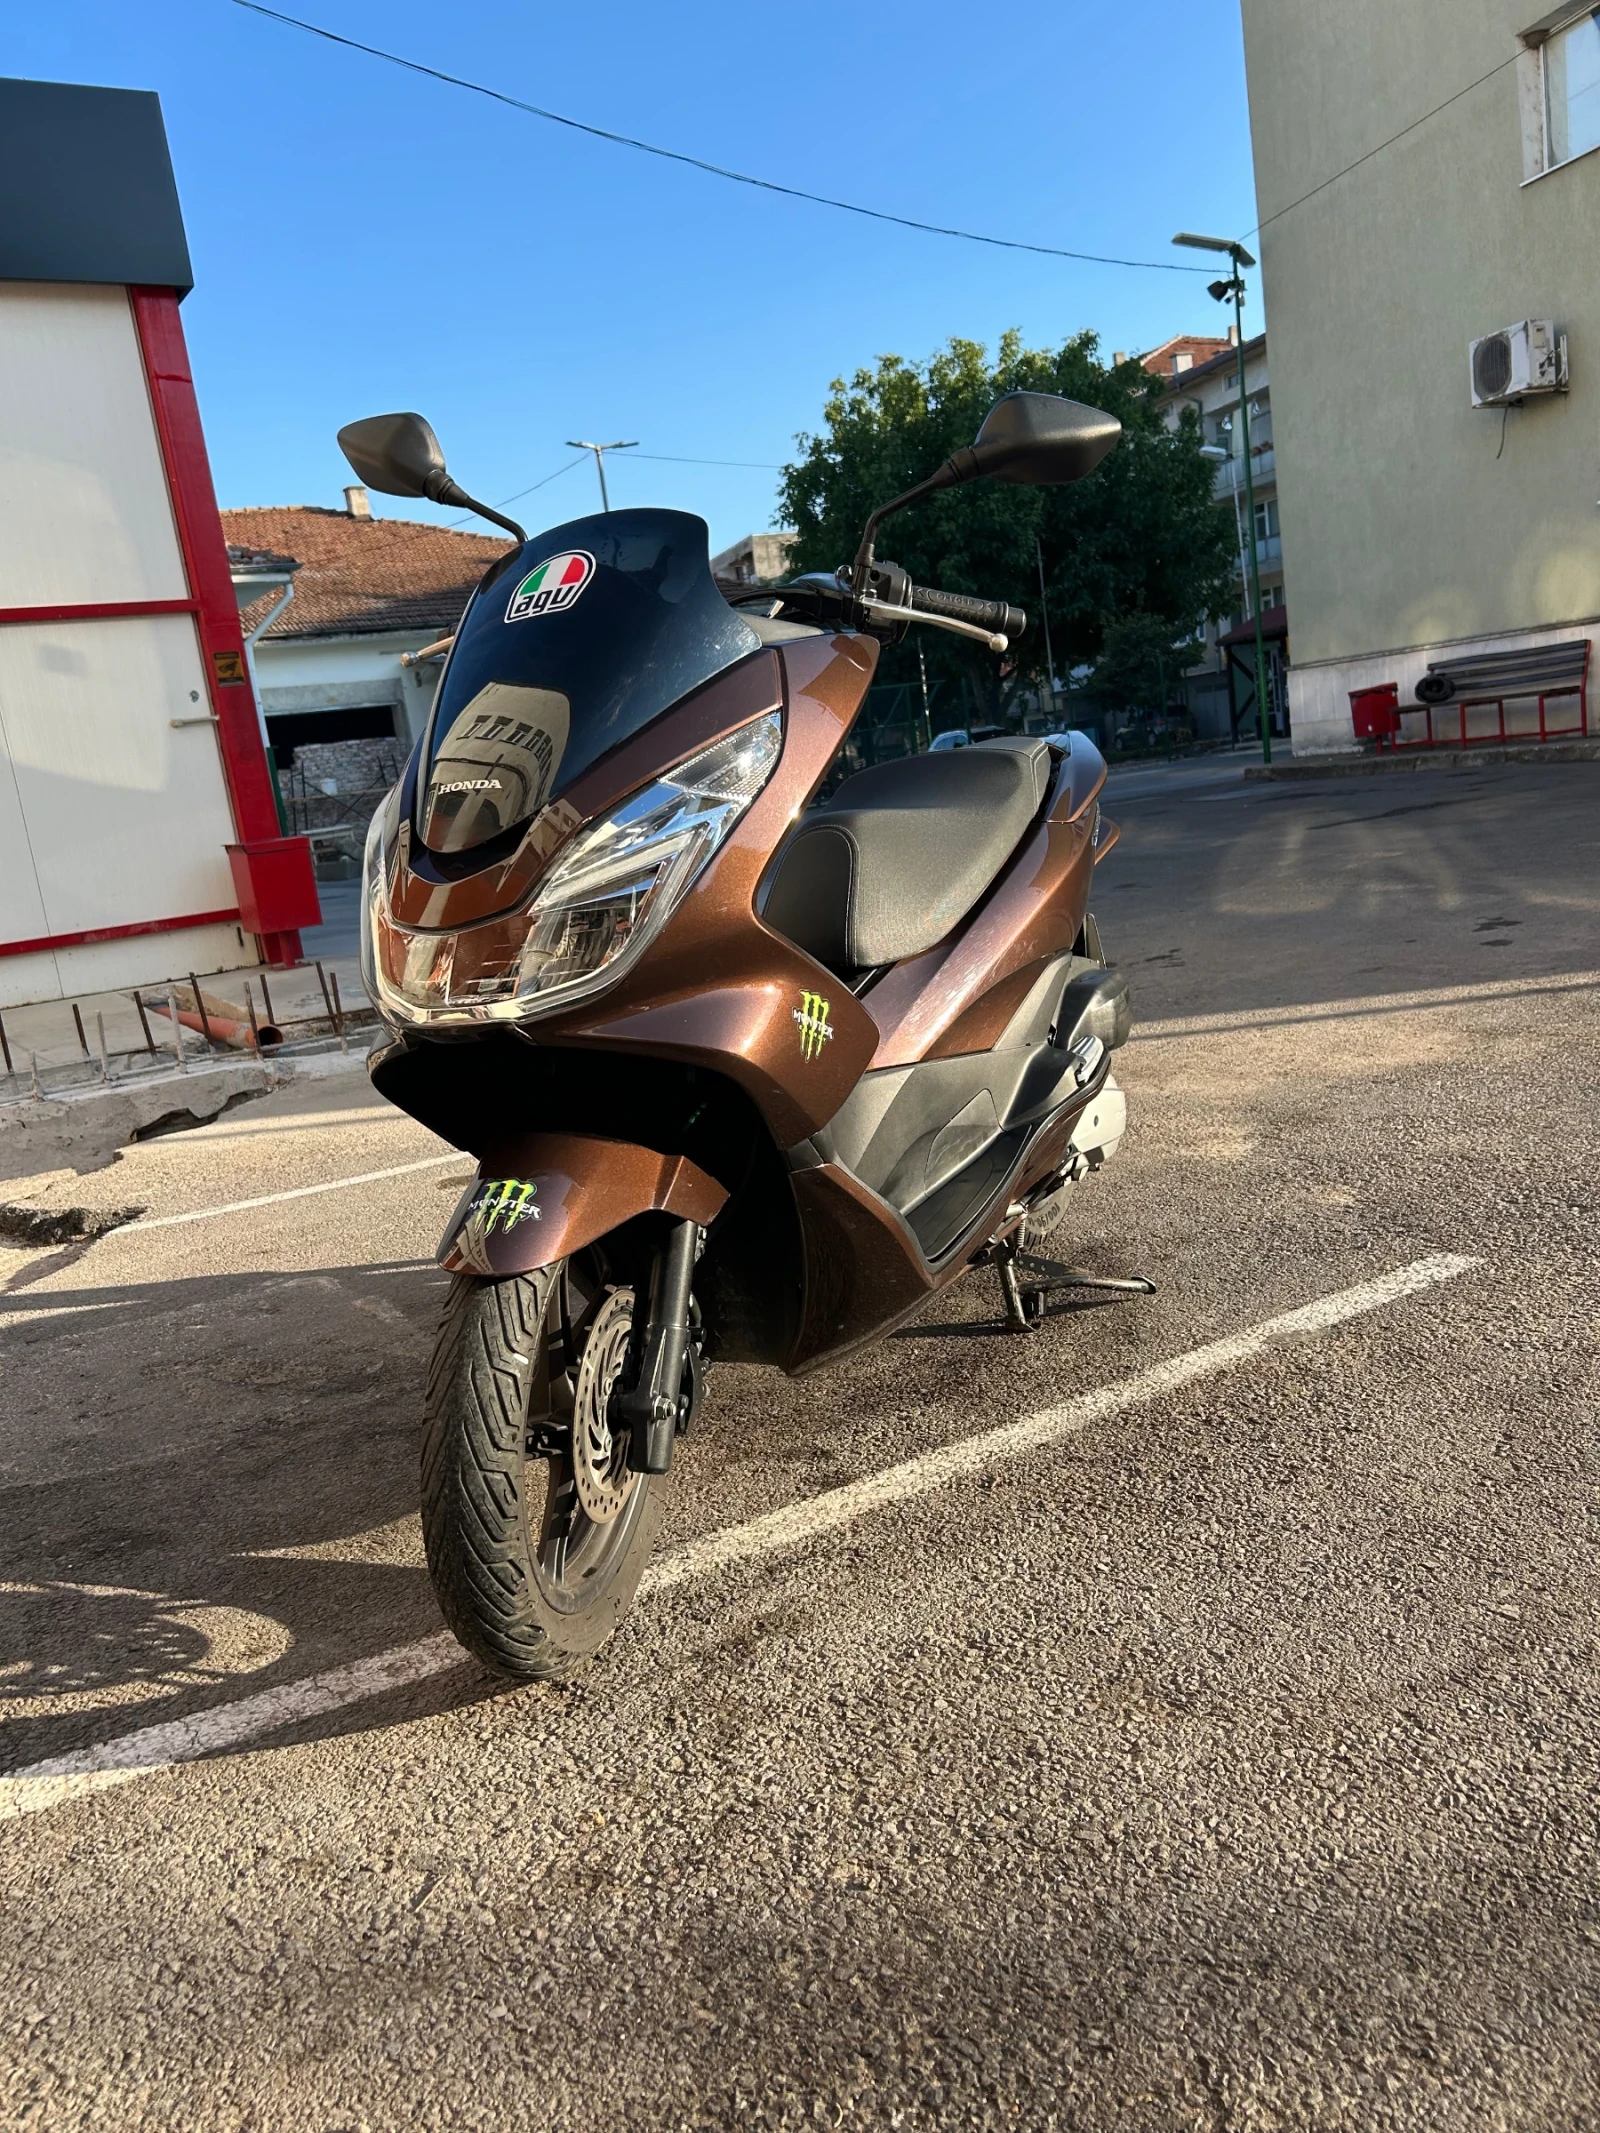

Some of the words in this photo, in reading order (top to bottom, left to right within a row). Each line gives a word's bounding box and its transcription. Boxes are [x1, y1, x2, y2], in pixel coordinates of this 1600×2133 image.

[514, 585, 576, 614] agv
[438, 779, 503, 795] HONDA
[467, 1196, 542, 1219] MONSTER
